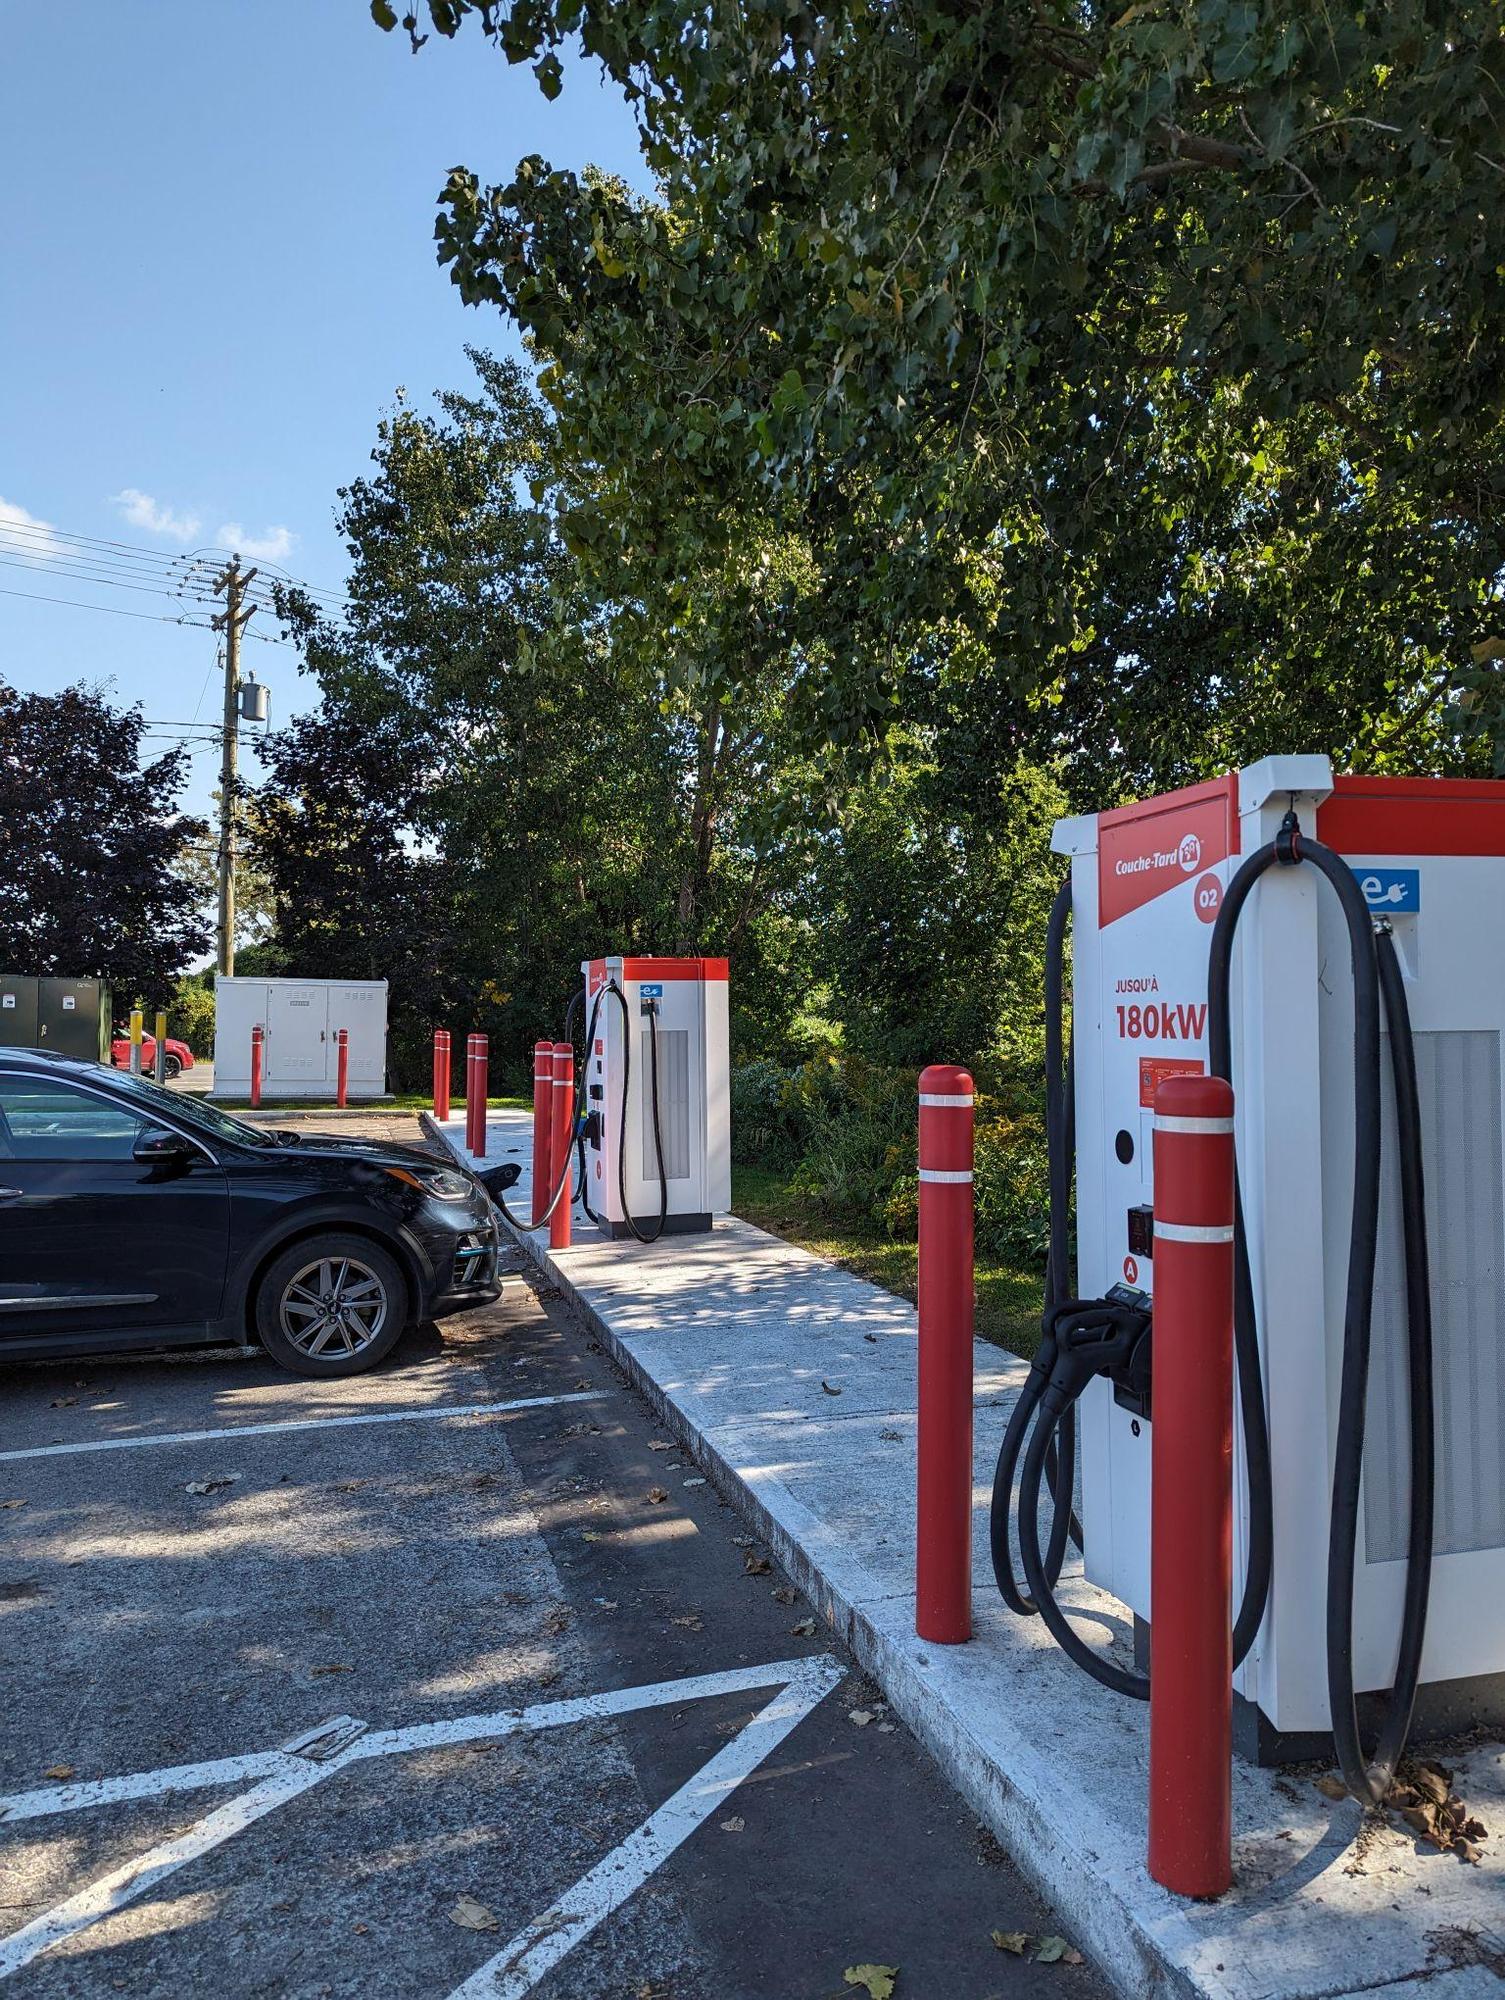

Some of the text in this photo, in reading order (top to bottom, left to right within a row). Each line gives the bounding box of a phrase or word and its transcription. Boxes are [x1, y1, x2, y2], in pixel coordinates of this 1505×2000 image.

[1115, 848, 1178, 875] Couche-Tard
[1199, 888, 1218, 908] 02
[1115, 973, 1159, 993] JUSQU'À
[1116, 1002, 1208, 1040] 180kW
[1126, 1261, 1135, 1279] A
